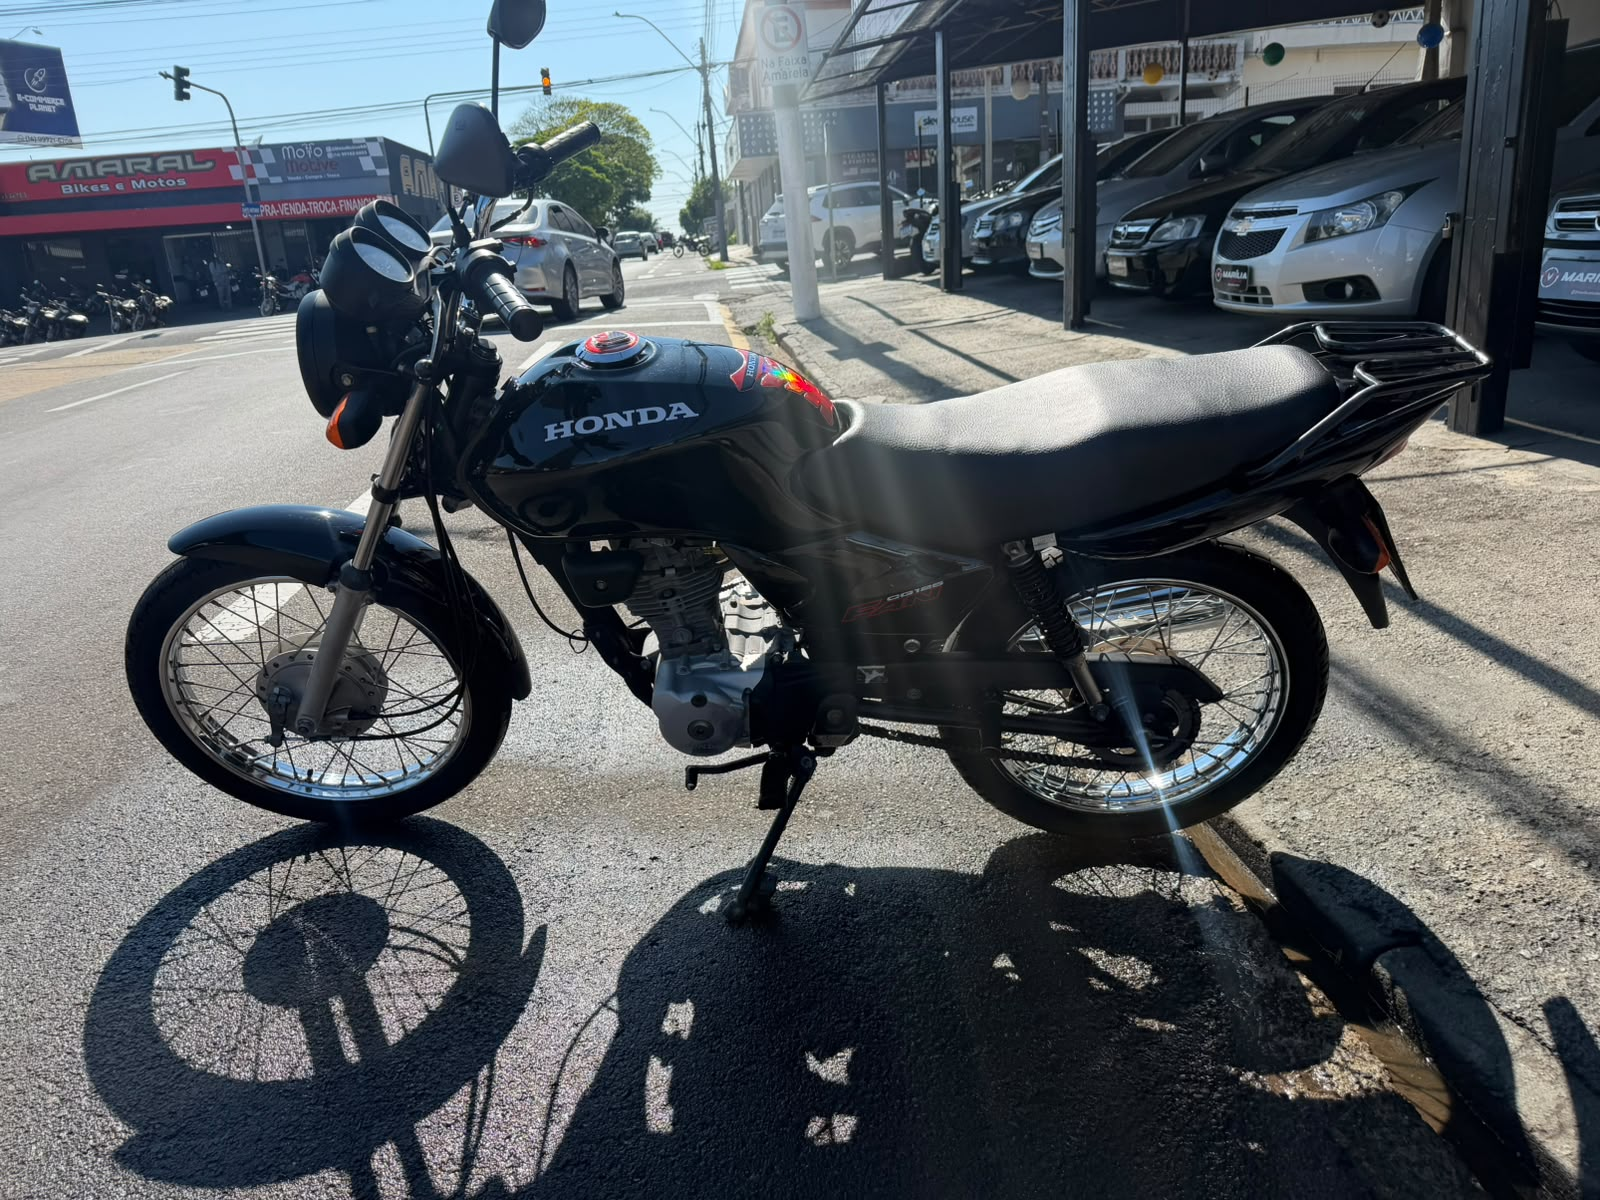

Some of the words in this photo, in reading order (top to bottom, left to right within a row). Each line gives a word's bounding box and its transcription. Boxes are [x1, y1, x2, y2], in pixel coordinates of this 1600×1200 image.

[778, 55, 807, 66] Faixa
[763, 68, 809, 82] Amarela
[29, 103, 56, 113] PLANET
[27, 153, 216, 183] AMARAL
[61, 182, 110, 194] Bikes
[115, 183, 125, 191] e
[131, 177, 187, 190] Motos
[543, 402, 700, 442] HONDA
